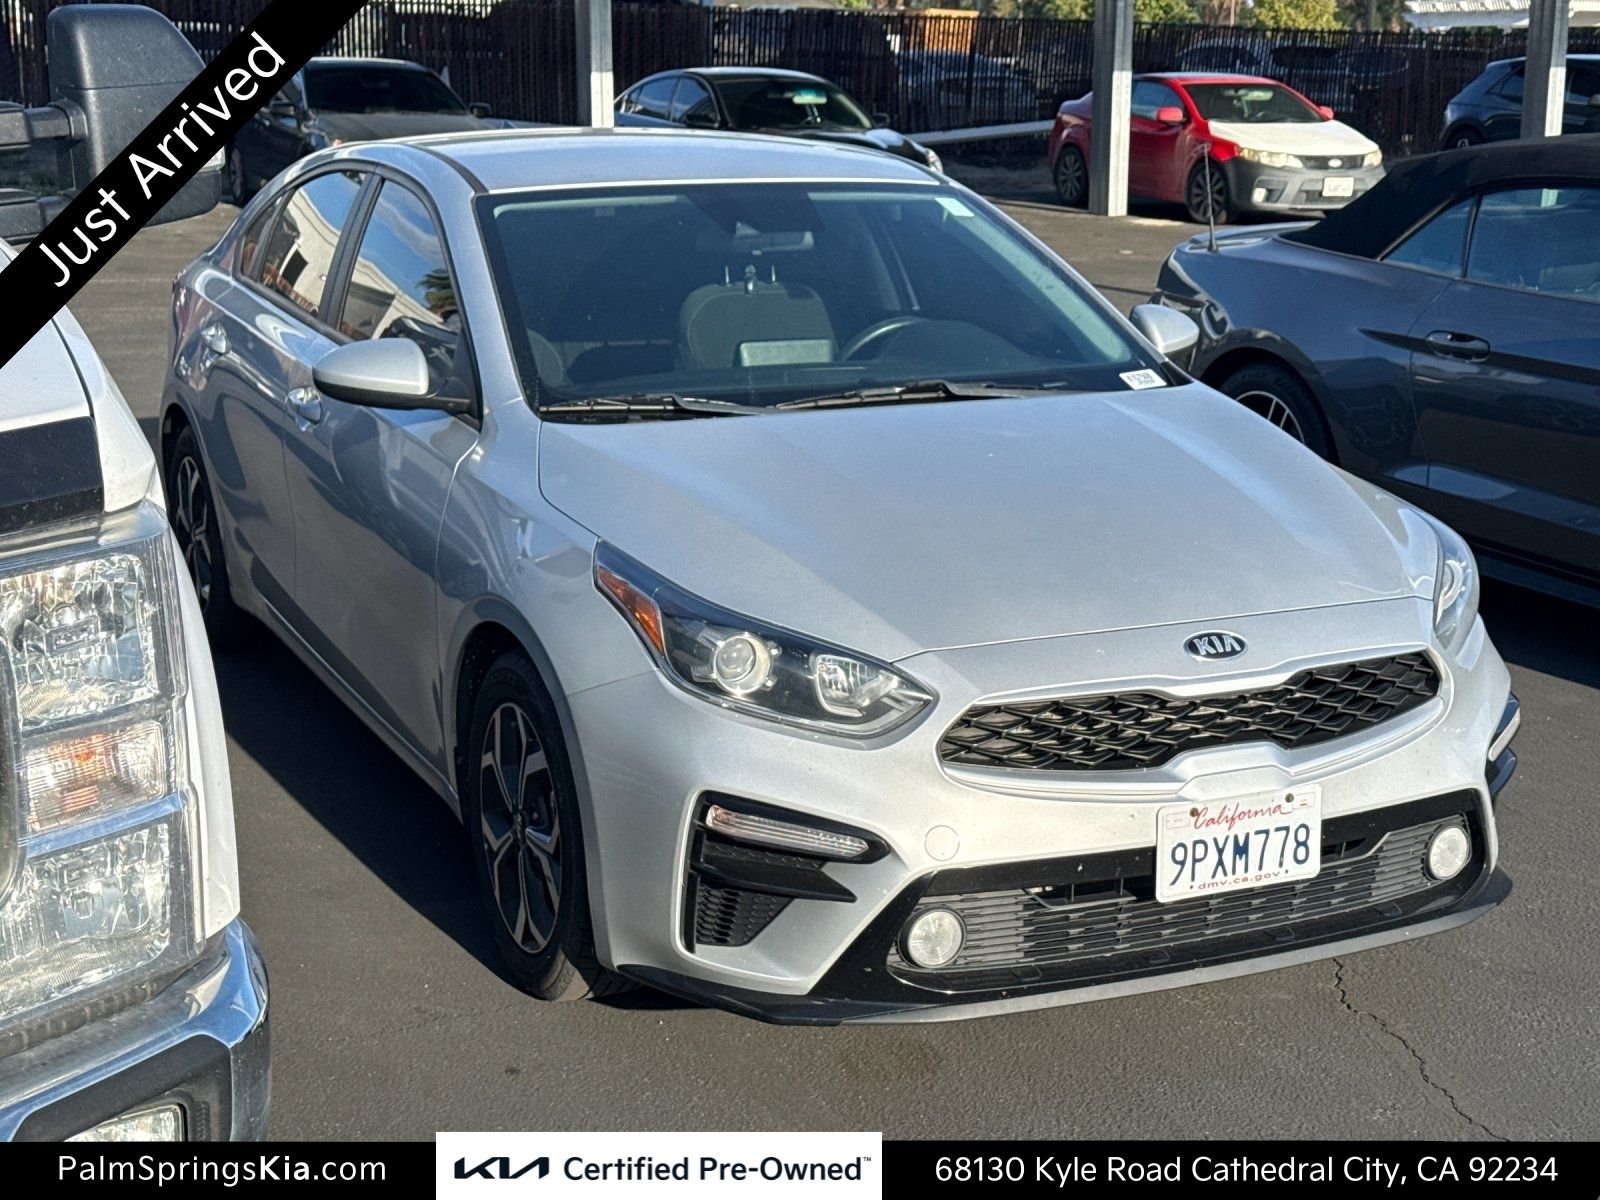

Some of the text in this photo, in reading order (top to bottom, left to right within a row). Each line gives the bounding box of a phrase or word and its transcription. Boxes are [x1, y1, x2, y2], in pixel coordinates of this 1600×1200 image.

[1192, 634, 1242, 656] KIA
[1192, 802, 1292, 831] California
[1169, 822, 1311, 886] 9PXM778
[1197, 871, 1280, 890] dmv.ca.gov
